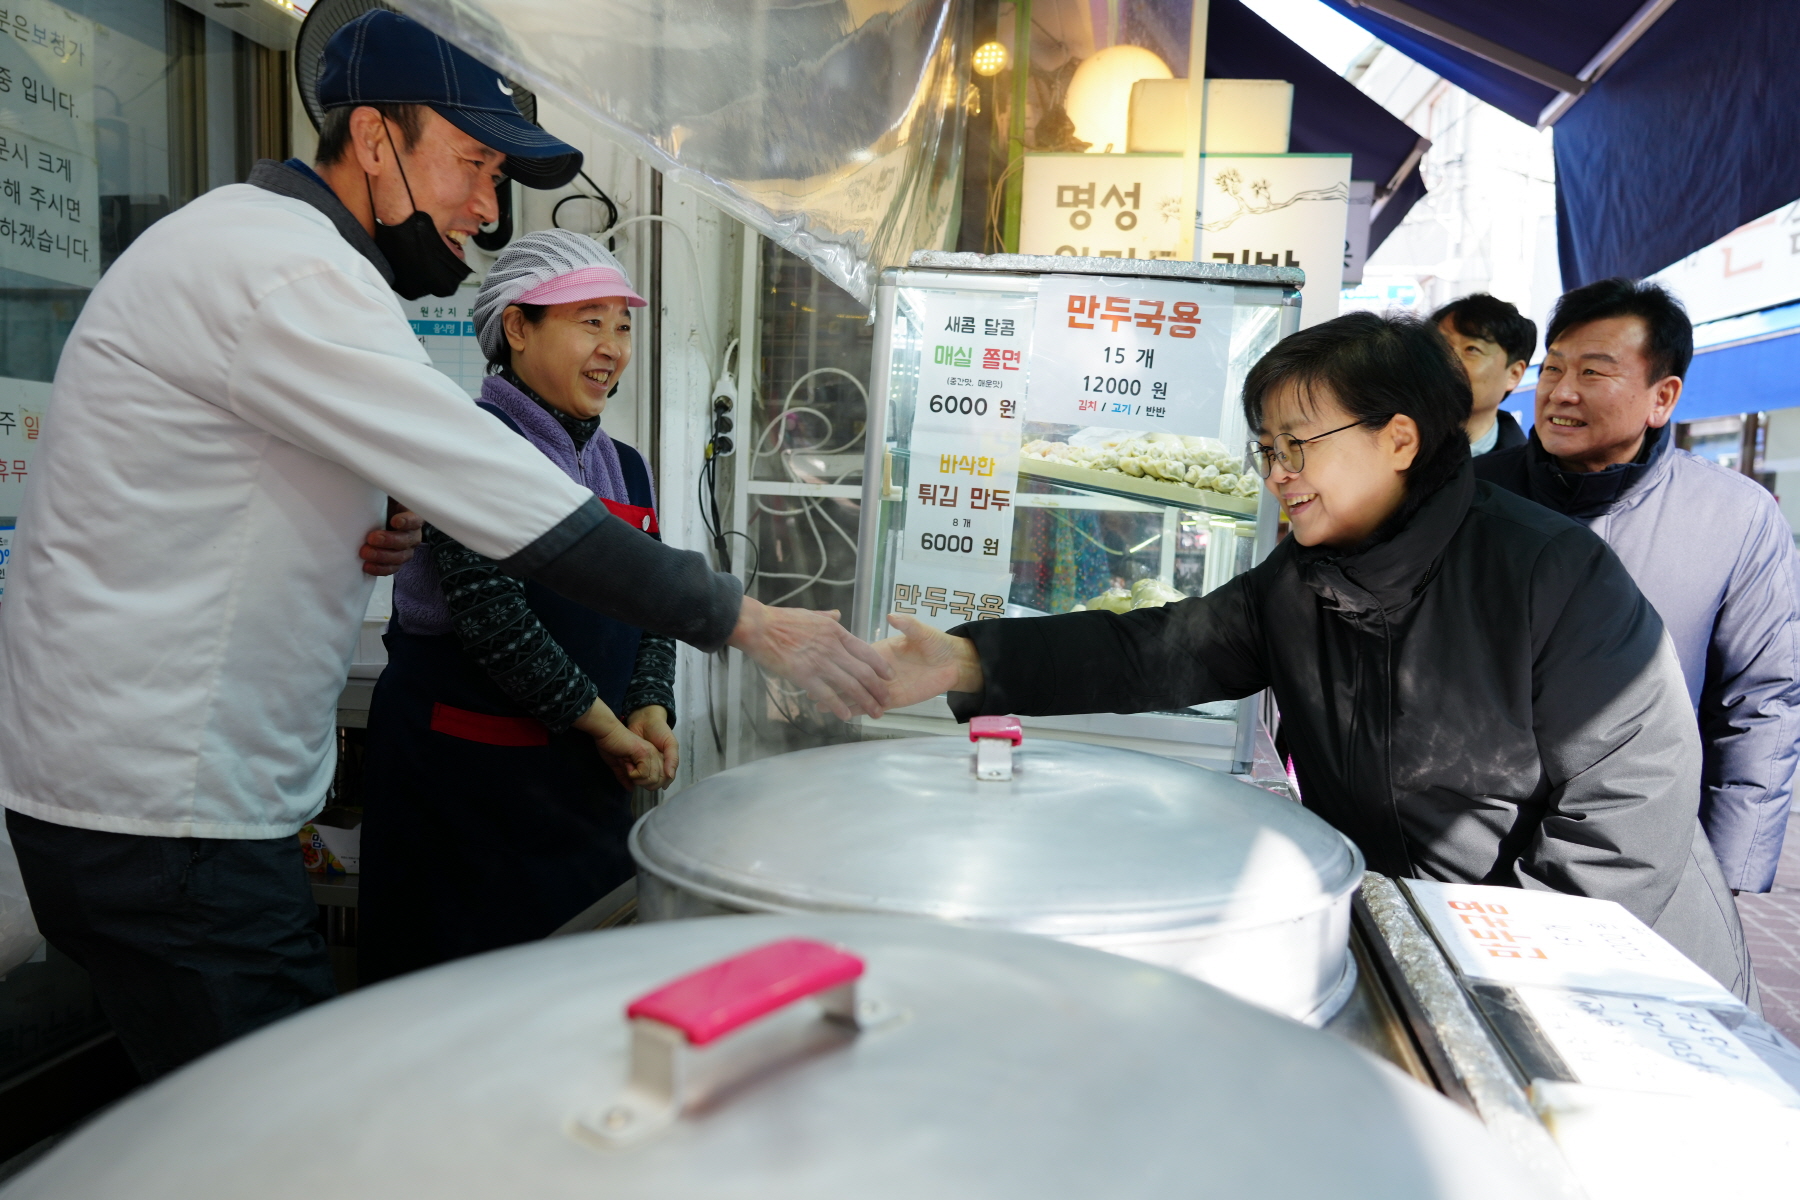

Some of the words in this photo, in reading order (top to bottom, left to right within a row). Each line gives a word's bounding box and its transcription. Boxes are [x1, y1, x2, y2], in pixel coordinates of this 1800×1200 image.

[22, 76, 79, 118] 입니다.
[38, 151, 71, 183] 크게
[0, 178, 20, 206] 해
[29, 186, 80, 223] 주시면
[1056, 182, 1141, 231] 명성
[420, 306, 456, 318] 원산지
[1067, 294, 1202, 339] 만두국용
[944, 316, 976, 334] 새콤
[984, 318, 1015, 336] 달콤
[934, 345, 972, 367] 매실
[982, 348, 1021, 371] 쫄면
[1104, 346, 1125, 364] 15
[1136, 348, 1154, 369] 개
[1083, 375, 1141, 396] 12000
[1151, 381, 1167, 400] 원
[929, 394, 988, 416] 6000
[999, 399, 1016, 419] 원
[1078, 399, 1097, 412] 김치
[1111, 403, 1131, 415] 고기
[1145, 406, 1166, 418] 반반
[24, 416, 39, 440] 일
[939, 453, 996, 477] 바삭한
[918, 483, 958, 508] 튀김
[970, 487, 1010, 512] 만두
[952, 518, 959, 527] 8
[963, 518, 971, 528] 개
[921, 532, 973, 554] 6000
[983, 537, 999, 556] 원
[894, 583, 1005, 622] 만두국용
